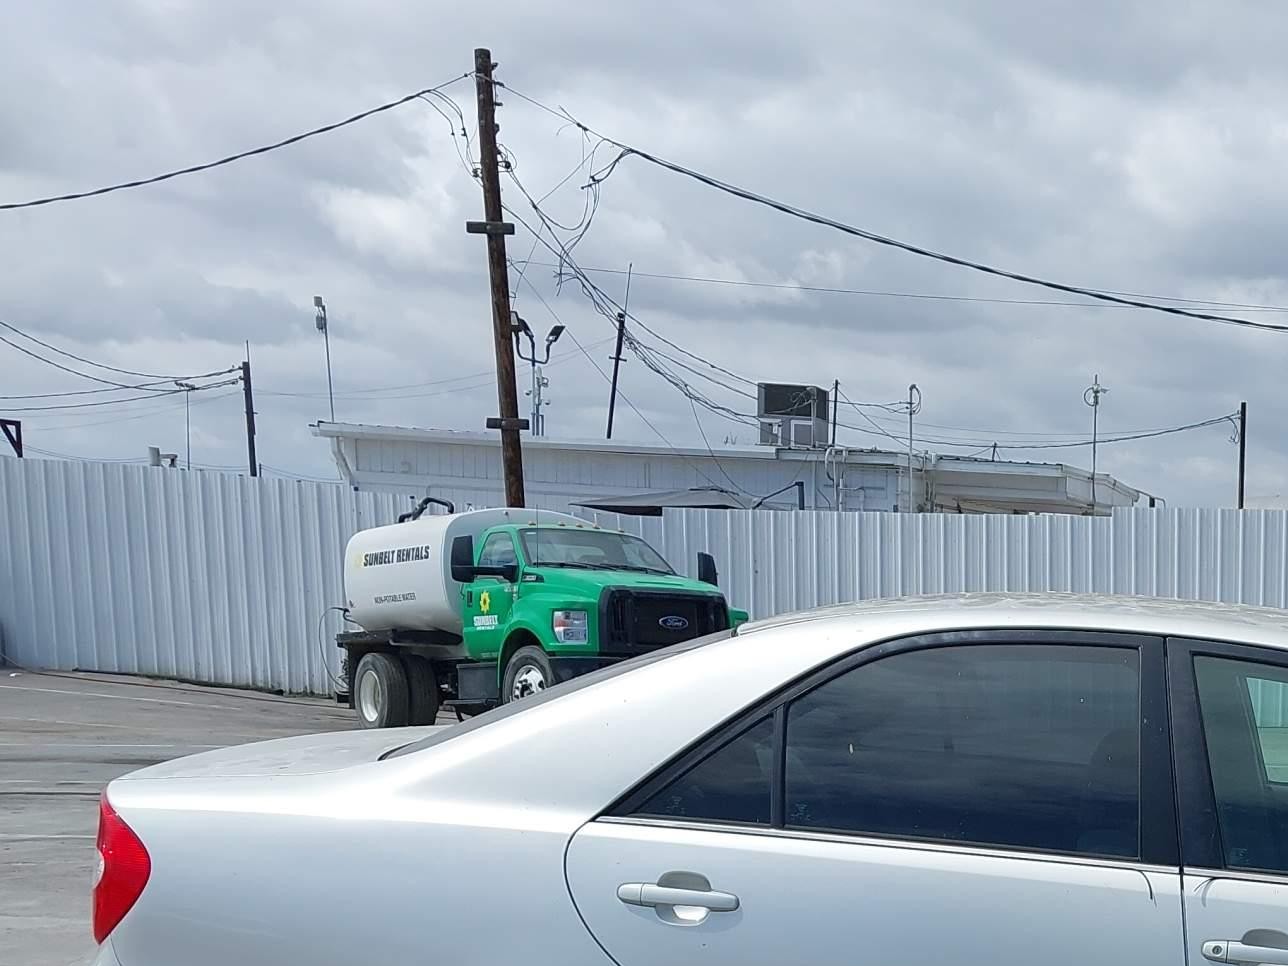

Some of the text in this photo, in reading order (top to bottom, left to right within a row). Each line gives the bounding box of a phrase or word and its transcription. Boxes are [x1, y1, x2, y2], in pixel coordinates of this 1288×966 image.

[363, 545, 430, 567] SUNBELT RENTALS
[473, 615, 498, 626] SUNBELT
[663, 617, 686, 627] Ford
